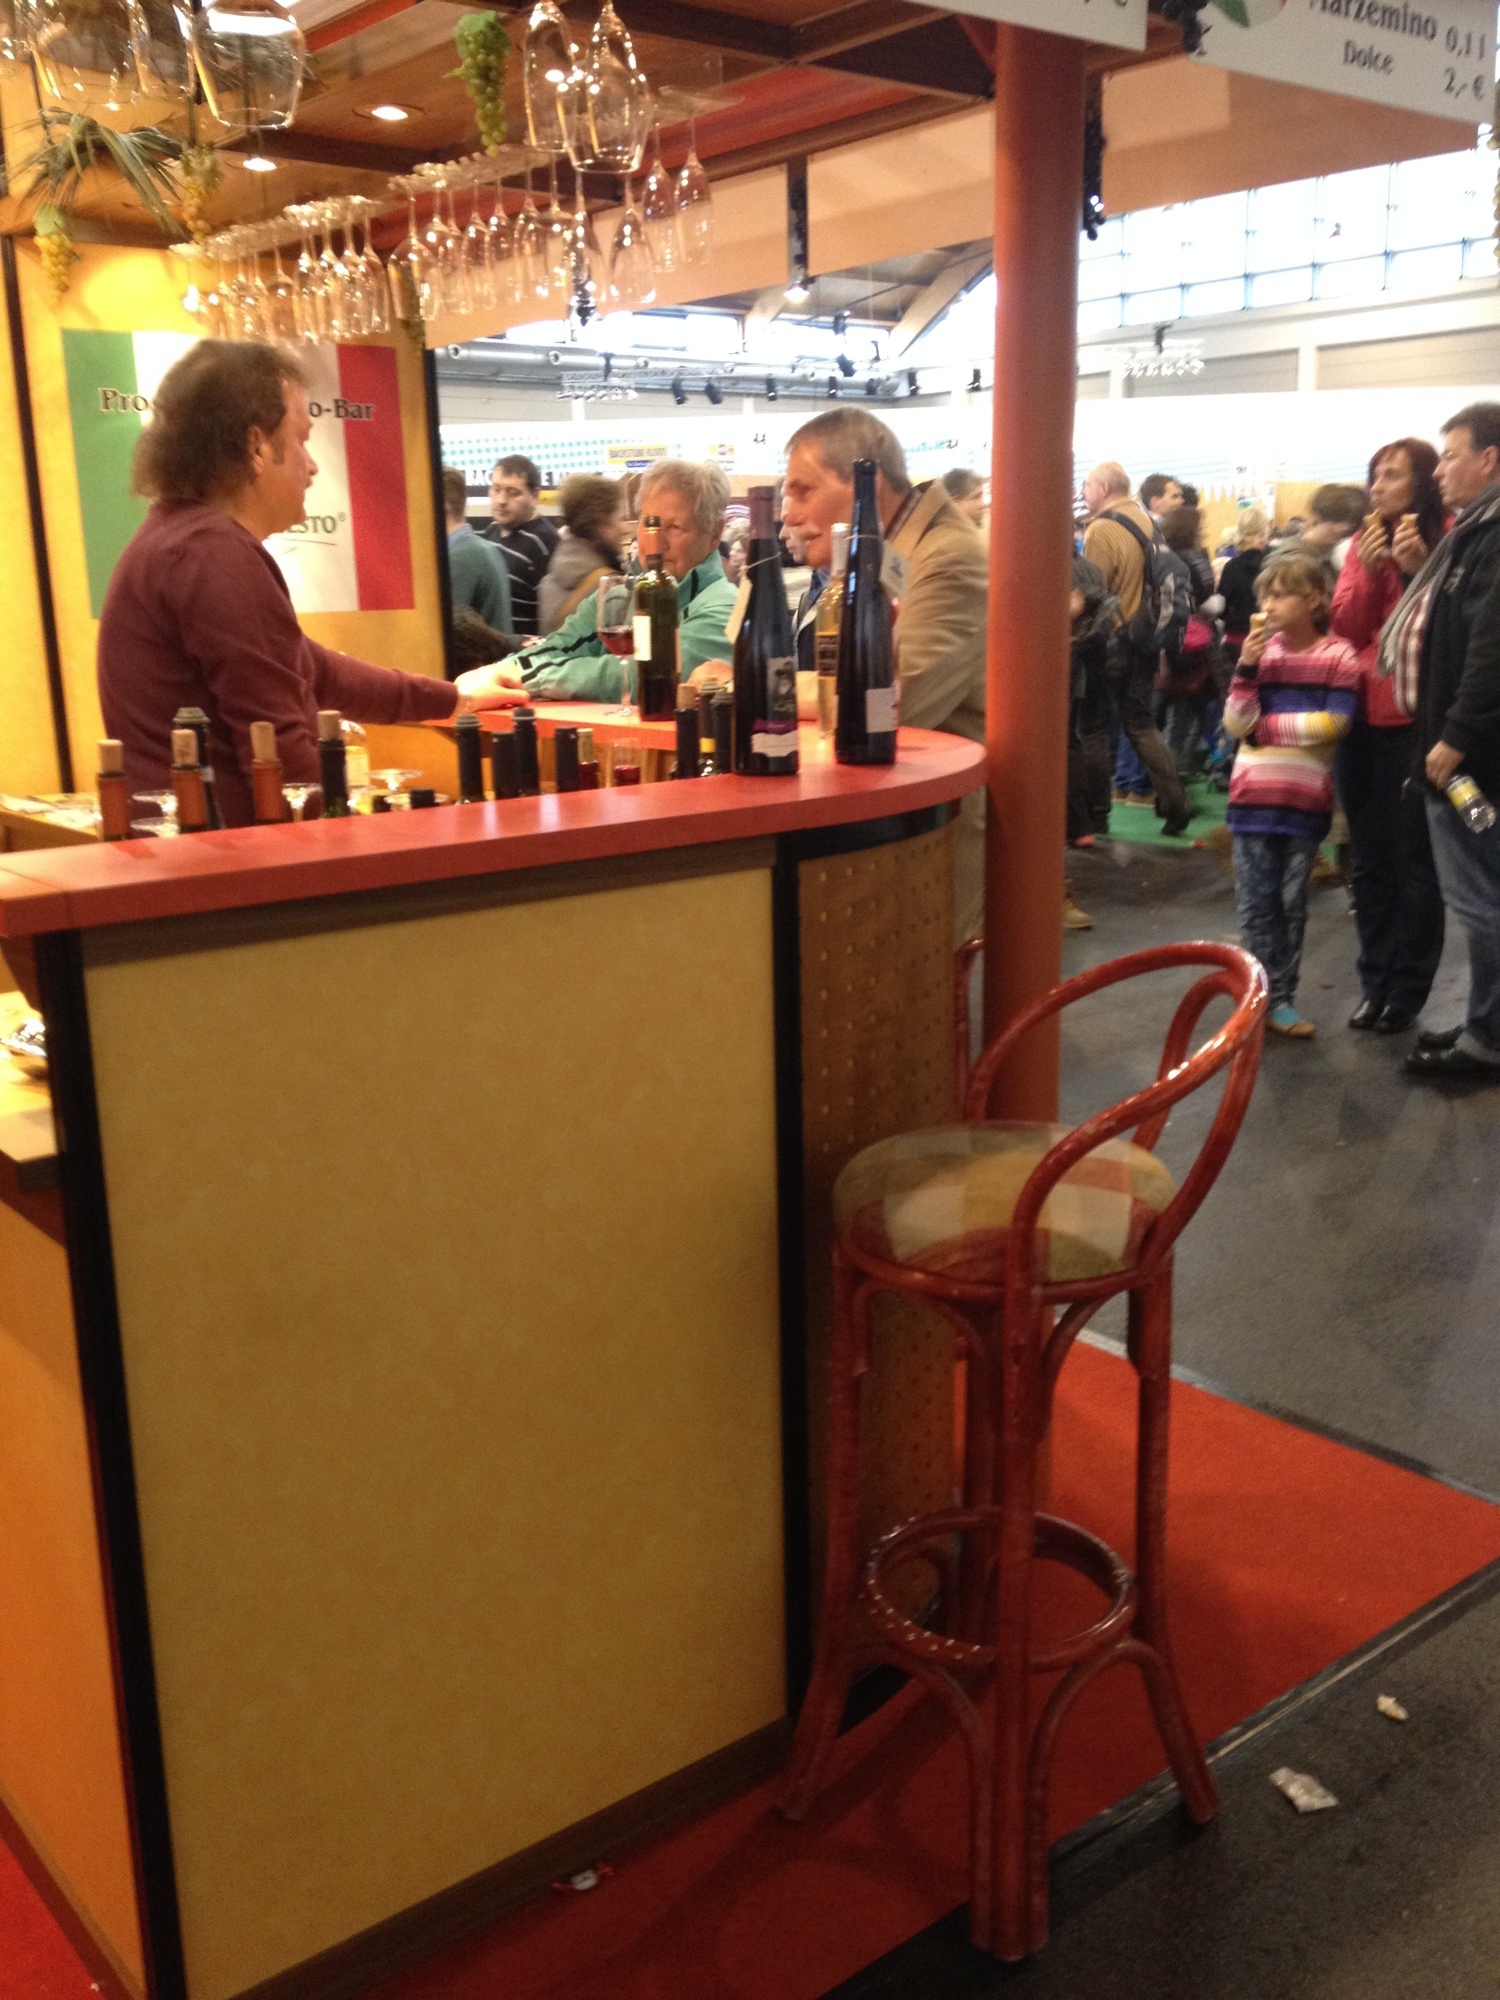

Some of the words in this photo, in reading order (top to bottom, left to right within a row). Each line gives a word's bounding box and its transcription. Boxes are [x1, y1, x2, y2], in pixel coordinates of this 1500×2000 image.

[1343, 40, 1395, 75] Dolce
[99, 388, 151, 412] Pro
[308, 398, 374, 420] o-Bar
